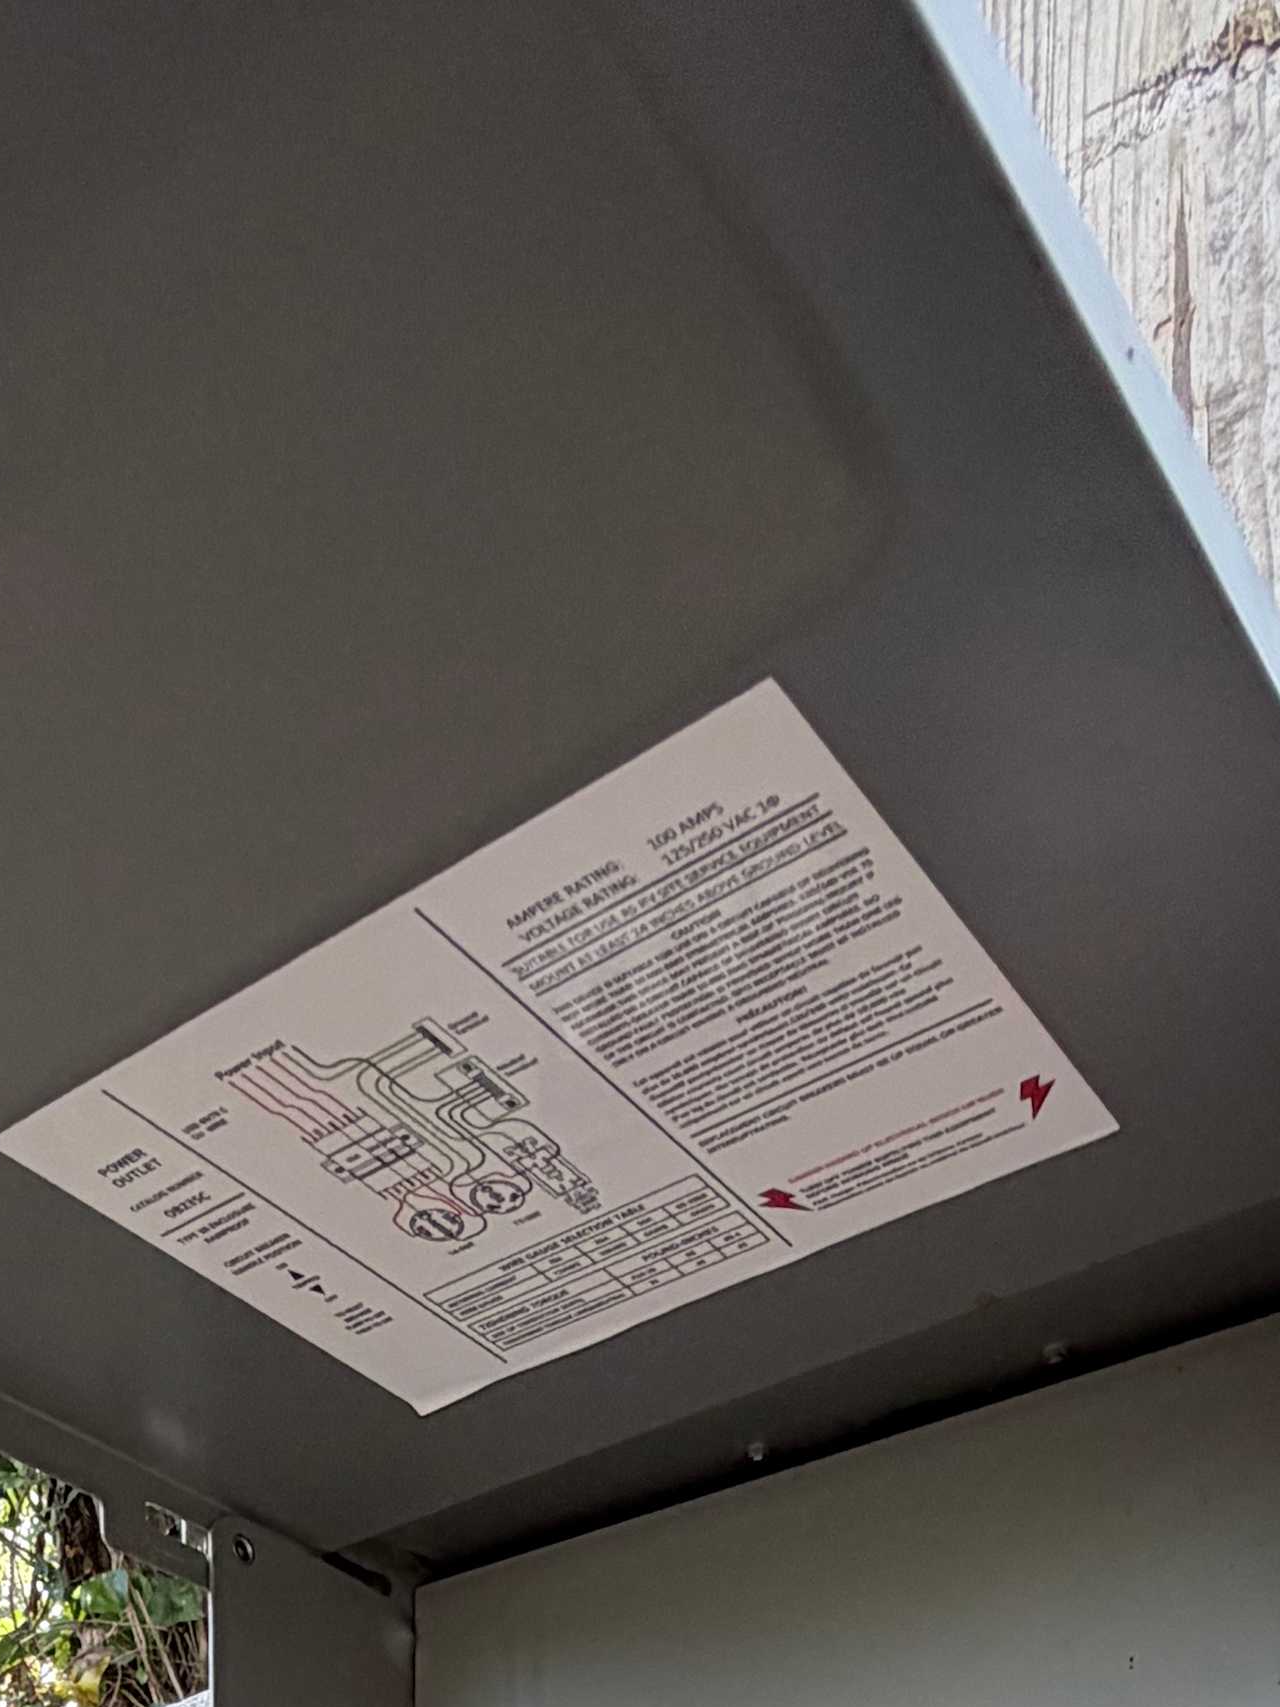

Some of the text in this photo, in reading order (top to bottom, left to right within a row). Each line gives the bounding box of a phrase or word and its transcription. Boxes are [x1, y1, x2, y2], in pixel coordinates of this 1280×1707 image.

[505, 890, 565, 930] AMPERE
[645, 826, 678, 851] 100
[677, 800, 724, 835] AMPS
[96, 1147, 148, 1178] POWER
[111, 1156, 162, 1189] OUTLET
